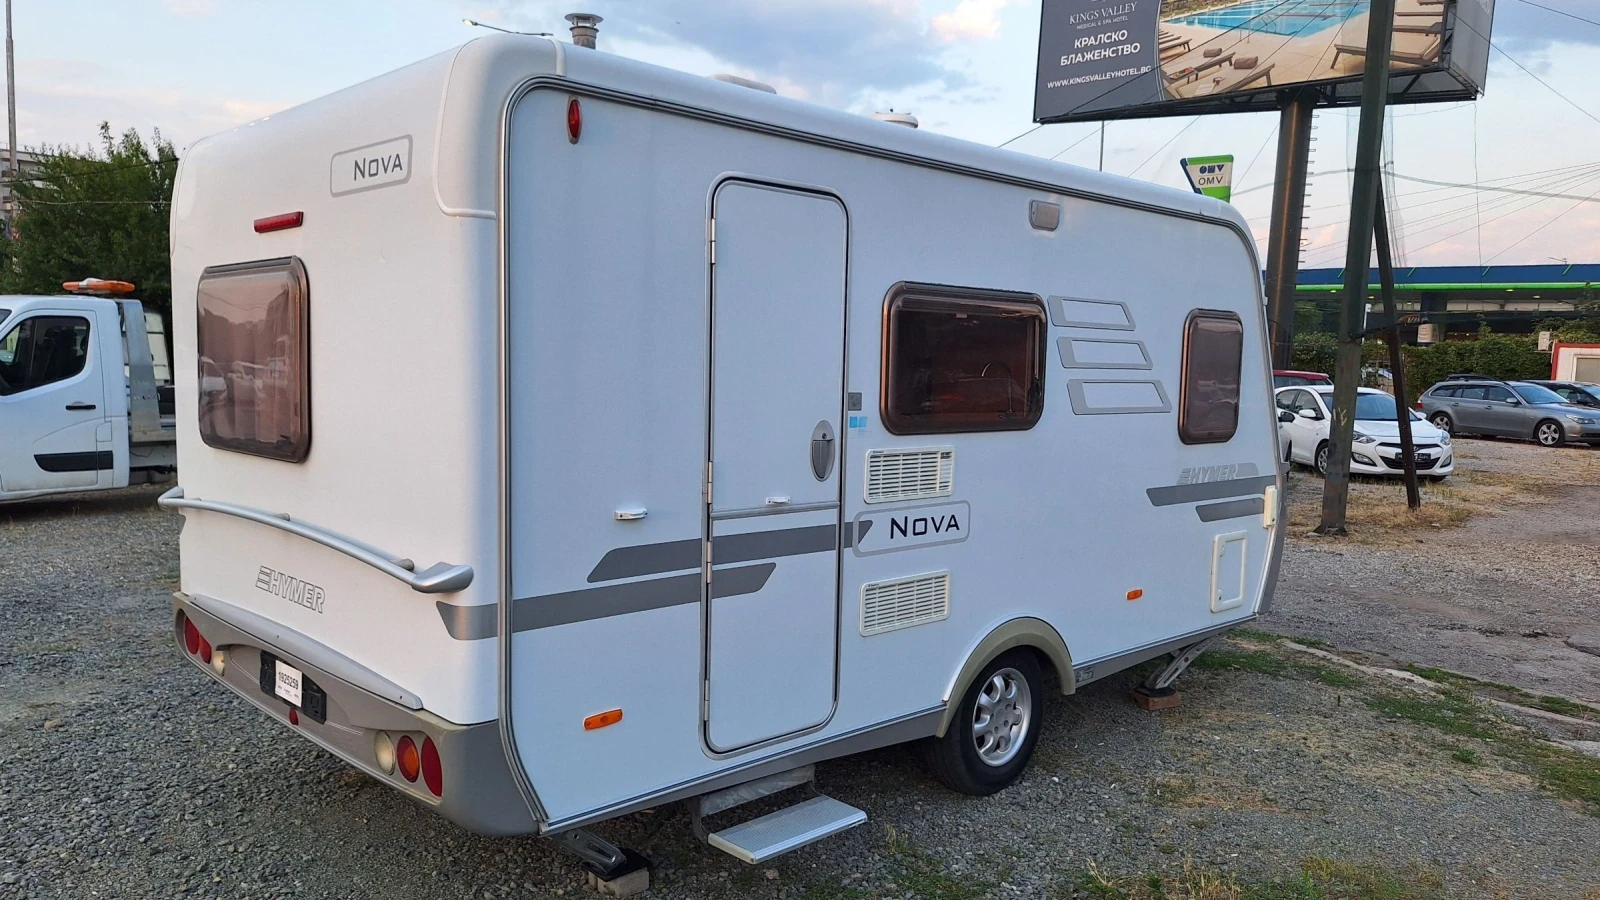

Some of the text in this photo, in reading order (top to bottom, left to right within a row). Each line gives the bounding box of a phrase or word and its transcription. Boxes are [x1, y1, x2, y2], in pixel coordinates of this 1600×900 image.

[1069, 1, 1138, 25] KINGS VALLEY
[1076, 22, 1097, 30] MEDICAL
[1102, 18, 1112, 26] SPA
[1112, 15, 1129, 23] HOTEL
[1074, 29, 1128, 49] КРАЛСКО
[1060, 42, 1140, 66] БЛАЖЕНСТВО
[1047, 65, 1152, 89] WWW.KINGSVALLEYHOTEL.BG
[354, 153, 403, 181] NOVA
[1199, 164, 1225, 174] OMV
[1198, 176, 1224, 186] OMV
[1186, 464, 1237, 485] HYMER
[890, 514, 960, 539] NOVA
[266, 567, 326, 614] HYMER
[278, 671, 299, 690] 1925259
